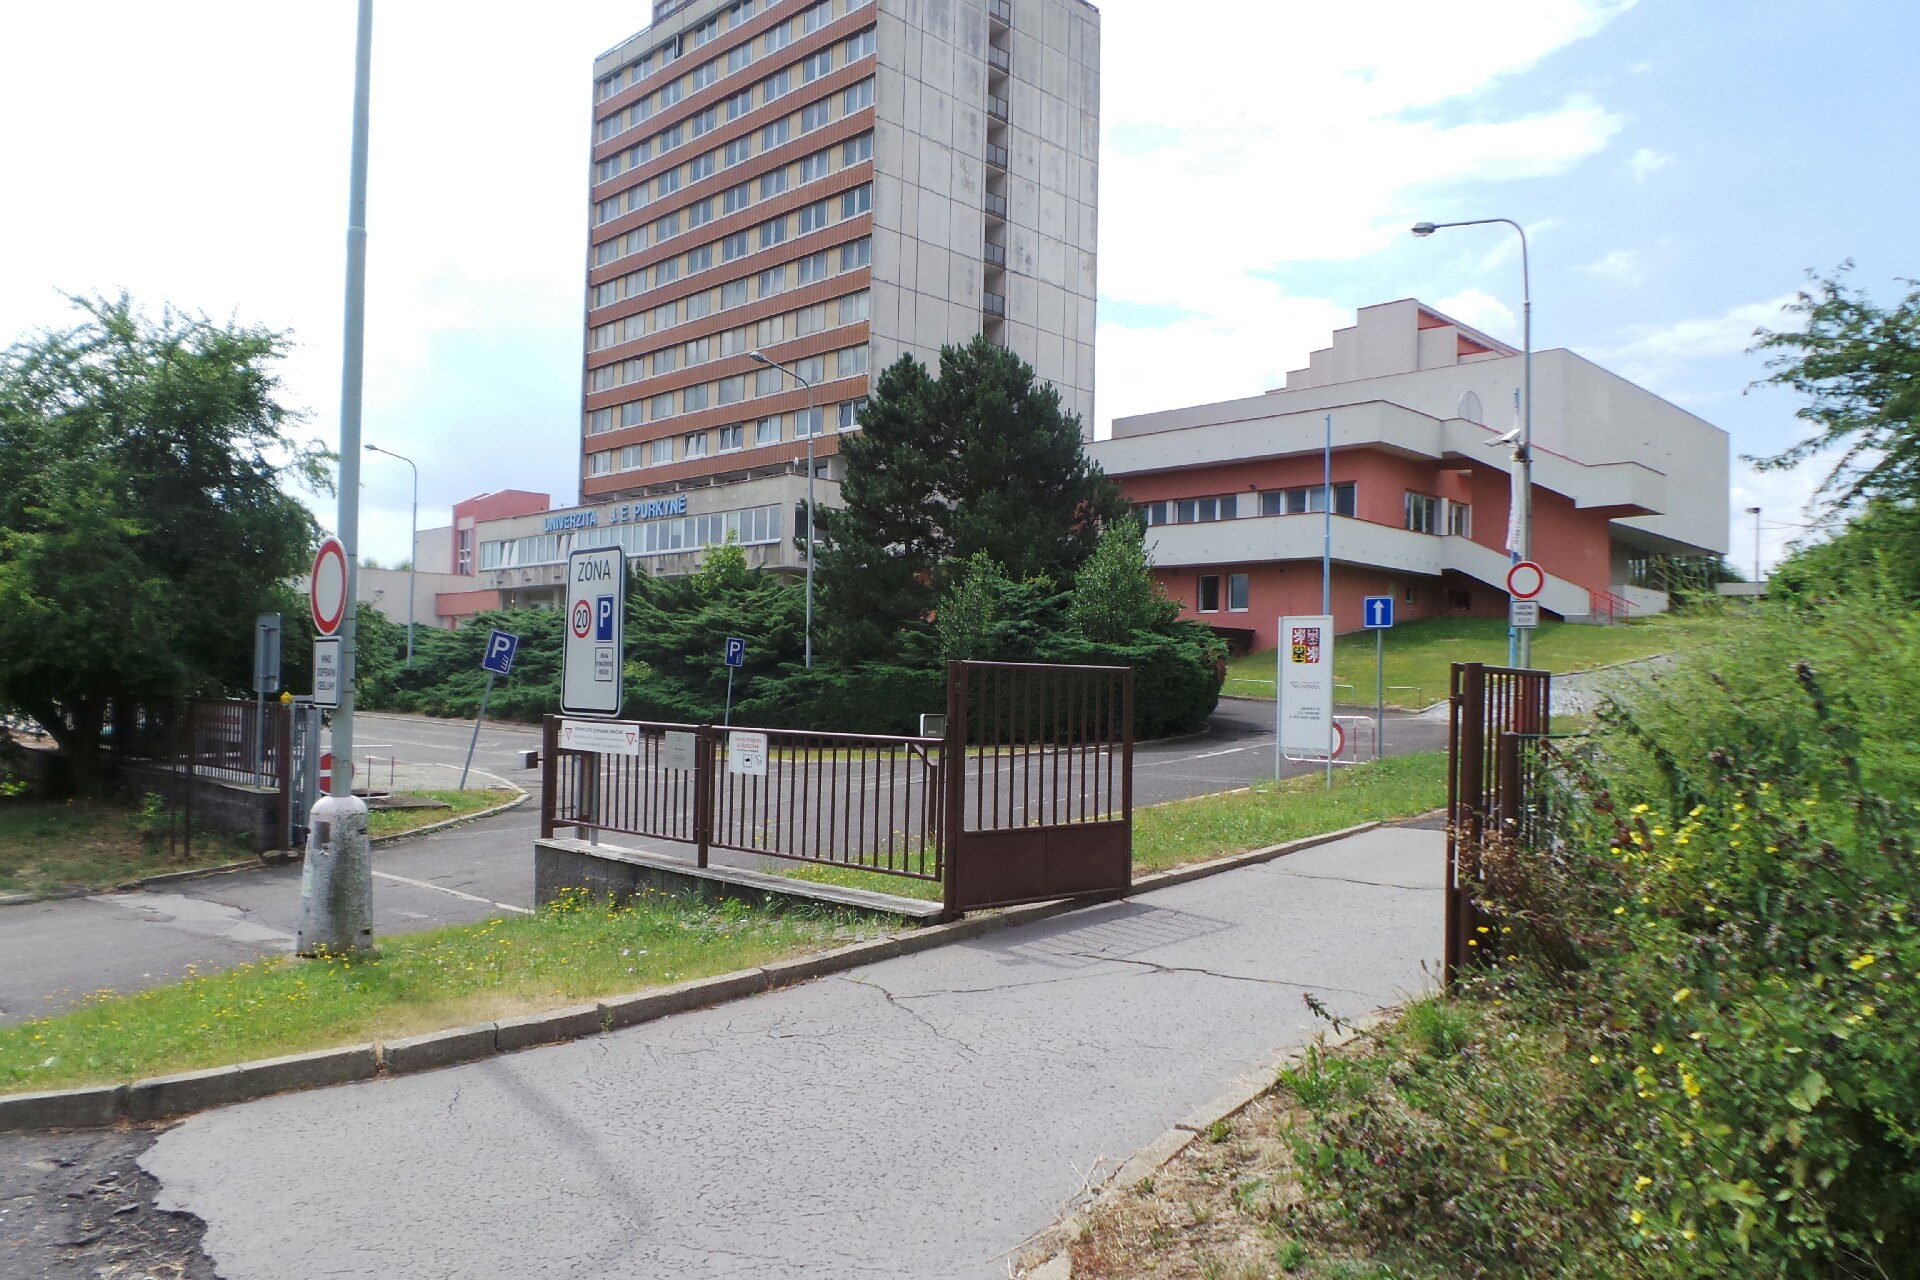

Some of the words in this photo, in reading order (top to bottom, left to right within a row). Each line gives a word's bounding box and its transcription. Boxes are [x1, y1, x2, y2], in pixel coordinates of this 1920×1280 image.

[544, 511, 598, 532] UNIVERZITA
[578, 556, 611, 582] ZÓNA
[576, 610, 588, 628] 20
[600, 601, 610, 628] P
[491, 636, 510, 658] P
[730, 642, 740, 657] P
